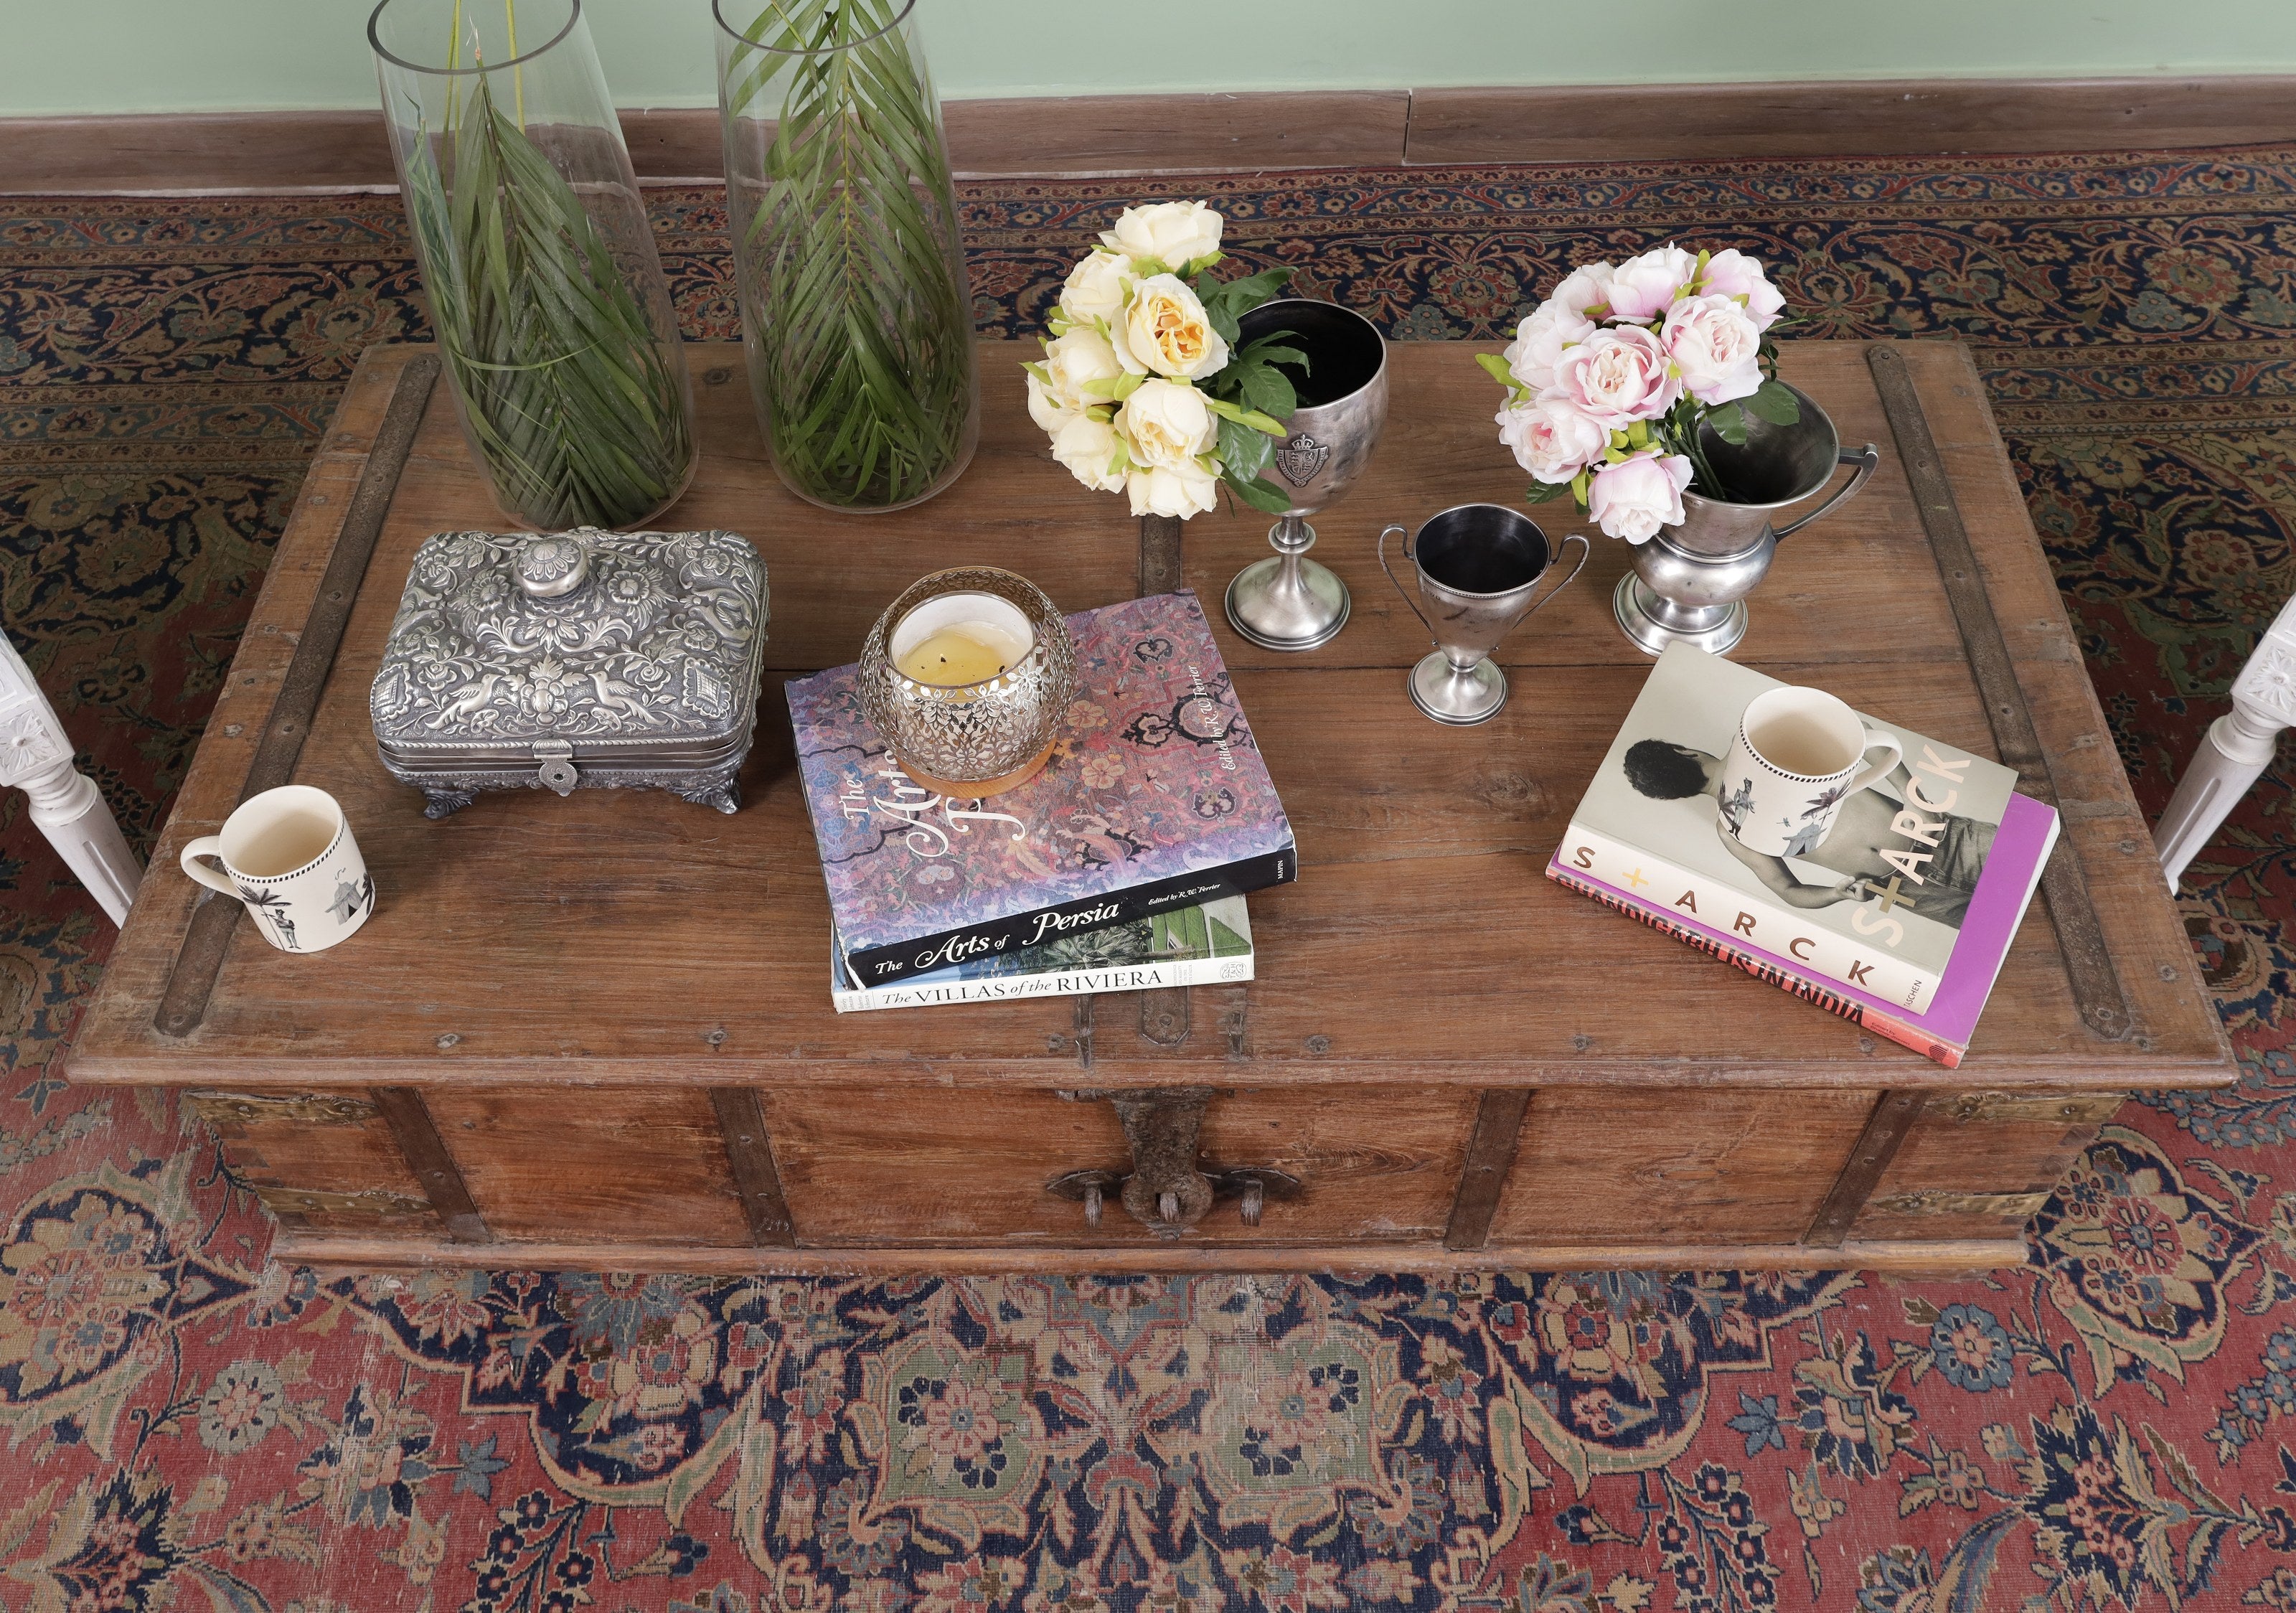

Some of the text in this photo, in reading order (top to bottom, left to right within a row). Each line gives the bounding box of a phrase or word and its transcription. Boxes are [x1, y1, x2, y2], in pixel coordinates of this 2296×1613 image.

[1210, 728, 1225, 740] by
[839, 779, 870, 820] The
[875, 960, 903, 974] The
[915, 935, 991, 969] Arts
[994, 934, 1010, 950] of
[1022, 903, 1120, 945] Persia
[1148, 895, 1170, 906] Edited
[883, 993, 911, 1005] The
[914, 983, 1005, 1002] VILLAS
[1010, 981, 1029, 996] of
[1029, 979, 1052, 992] the
[1056, 970, 1164, 991] RIVIERA
[1791, 977, 1864, 1026] INDIA
[1904, 979, 1922, 1008] TASCHEN
